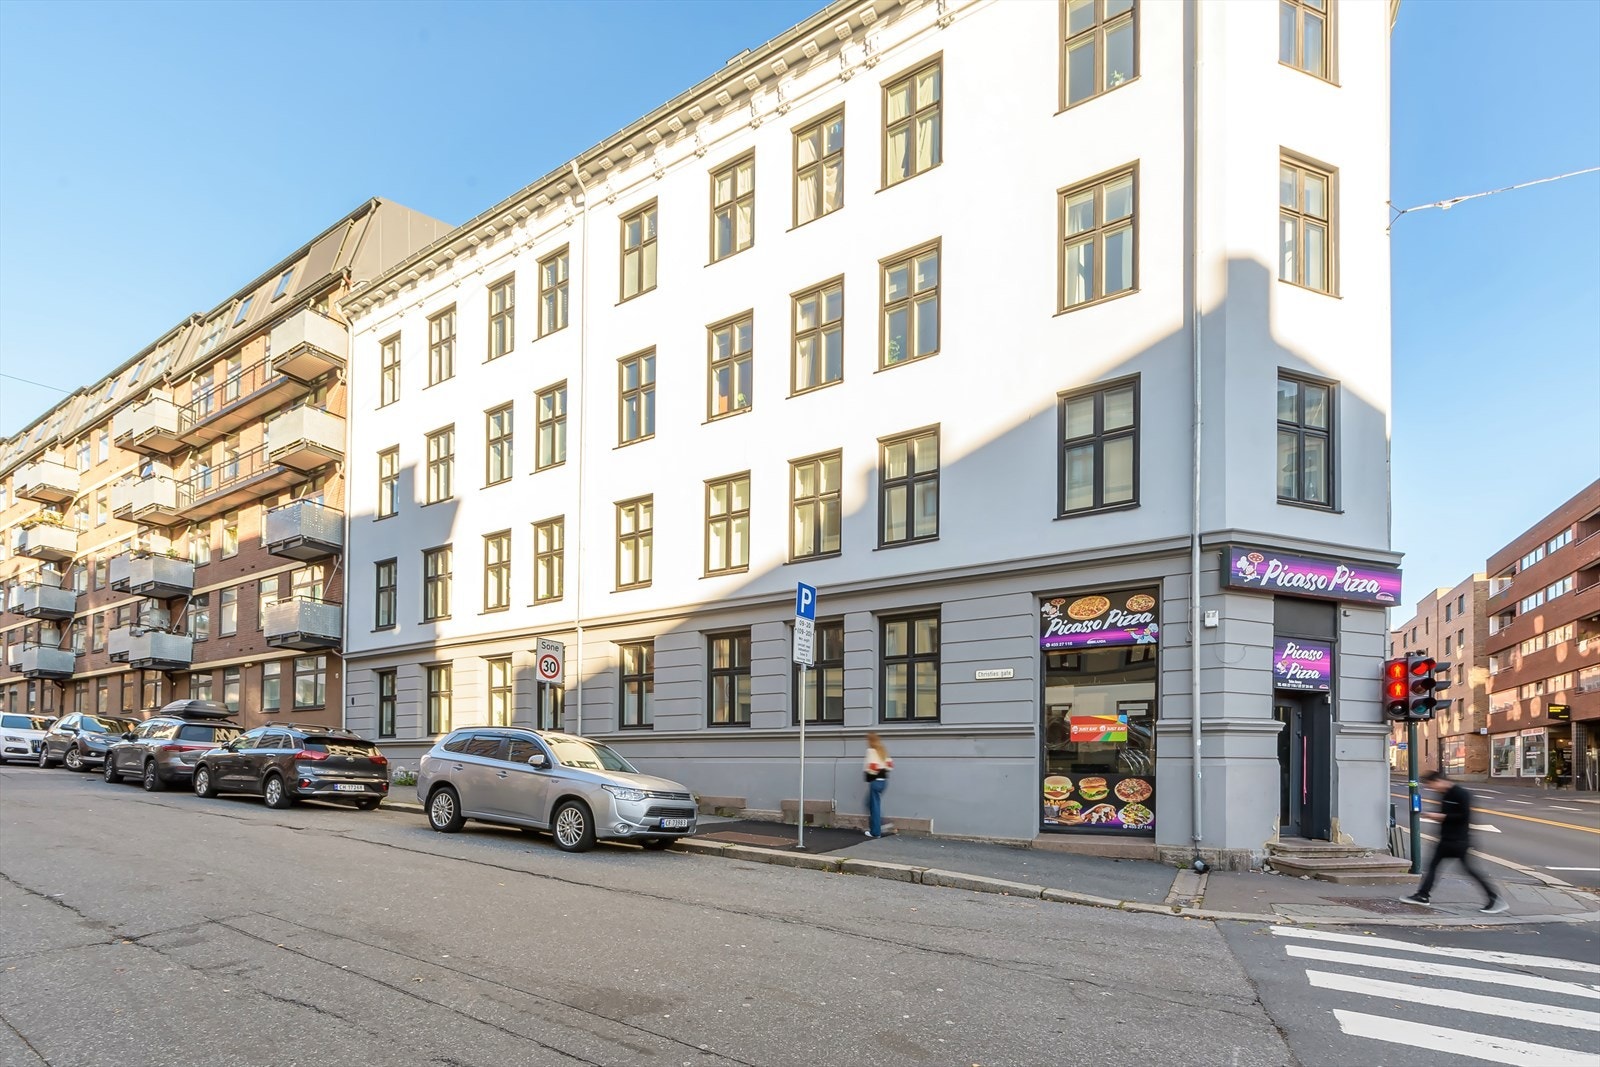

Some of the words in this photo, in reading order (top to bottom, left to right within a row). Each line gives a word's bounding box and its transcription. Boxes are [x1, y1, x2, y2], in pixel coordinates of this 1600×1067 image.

[1260, 559, 1327, 591] Picasso
[1328, 565, 1381, 593] Pizza
[801, 587, 812, 613] P
[1044, 618, 1102, 638] Picasso
[1103, 609, 1154, 630] Pizza
[541, 641, 559, 652] Sone
[1282, 642, 1323, 661] Picasso
[543, 660, 556, 673] 30
[1286, 662, 1321, 679] Pizza
